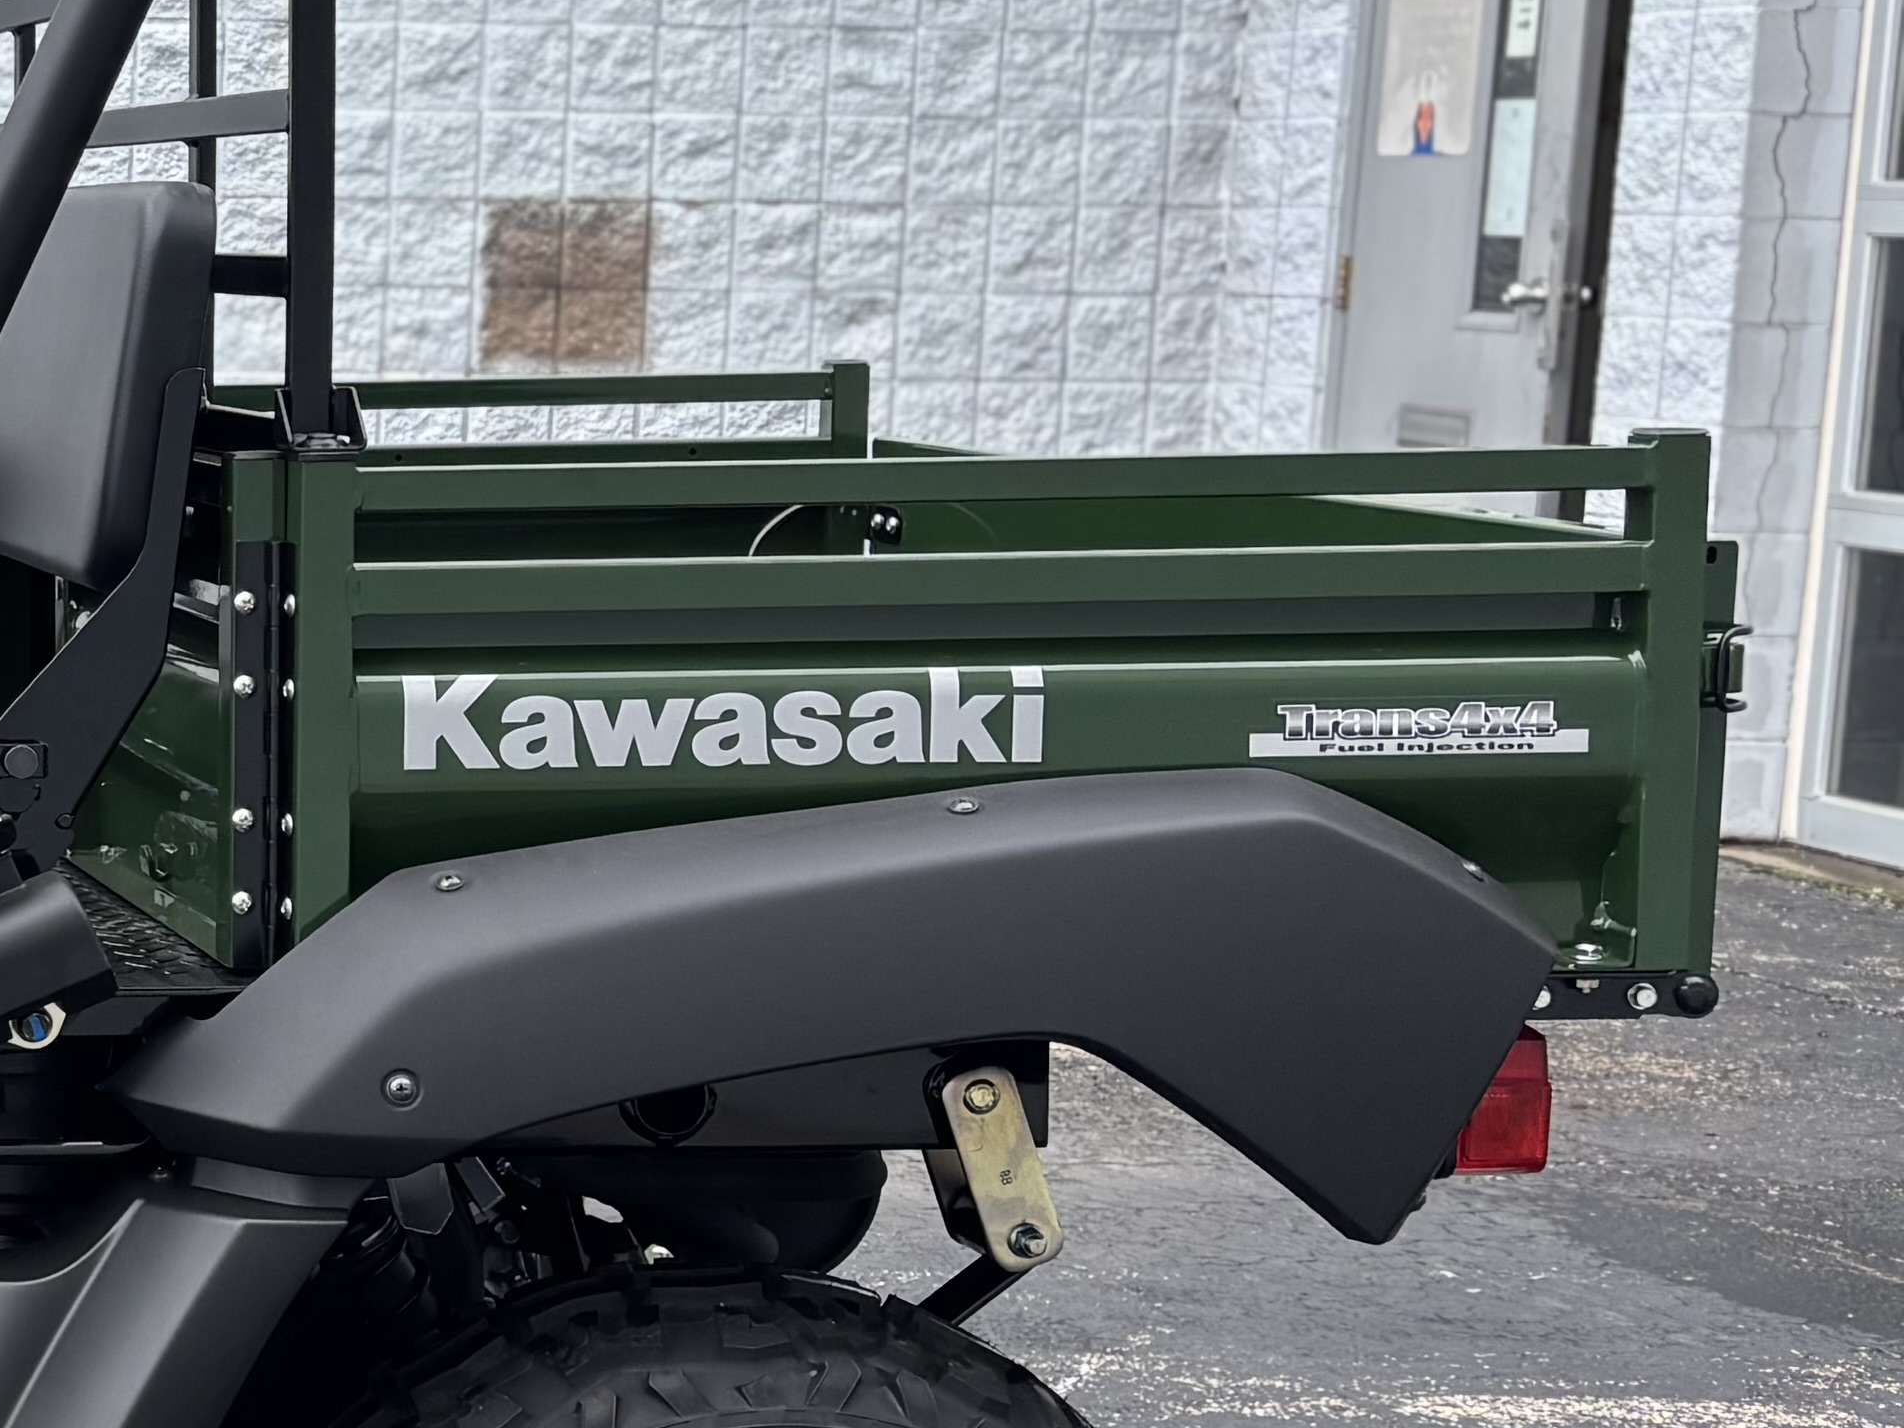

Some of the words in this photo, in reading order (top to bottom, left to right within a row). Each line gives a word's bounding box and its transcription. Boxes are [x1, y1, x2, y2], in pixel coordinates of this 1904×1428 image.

[401, 666, 1044, 770] Kawasaki
[1277, 700, 1558, 741] Trans4x4
[1319, 742, 1384, 753] Fuel
[1396, 741, 1535, 753] Injection
